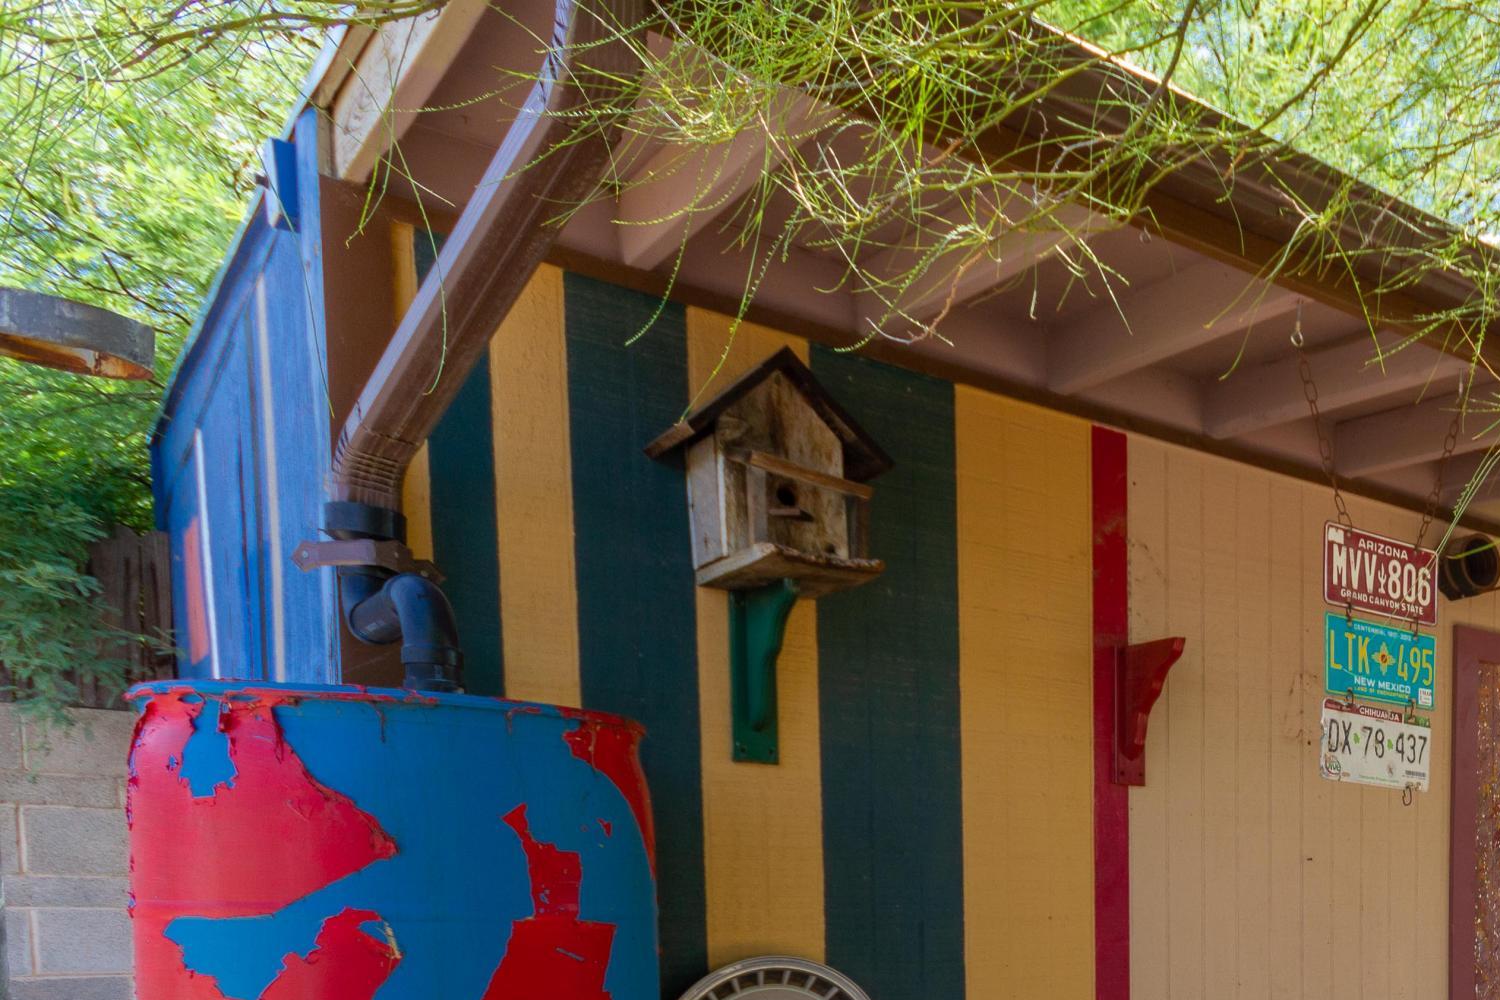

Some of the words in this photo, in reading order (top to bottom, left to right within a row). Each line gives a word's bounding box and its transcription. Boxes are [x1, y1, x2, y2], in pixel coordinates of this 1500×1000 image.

[1358, 538, 1409, 560] ARIZONA
[1332, 543, 1377, 593] MVV
[1387, 559, 1431, 607] 806
[1340, 588, 1368, 602] GRAND
[1368, 596, 1401, 609] CANYON
[1401, 602, 1424, 616] STATE
[1330, 629, 1371, 675] LTK
[1397, 644, 1433, 686] 495
[1354, 675, 1375, 687] NEW
[1378, 680, 1411, 694] MEXICO
[1327, 718, 1352, 755] DX
[1361, 726, 1385, 758] 78
[1395, 732, 1428, 764] 437
